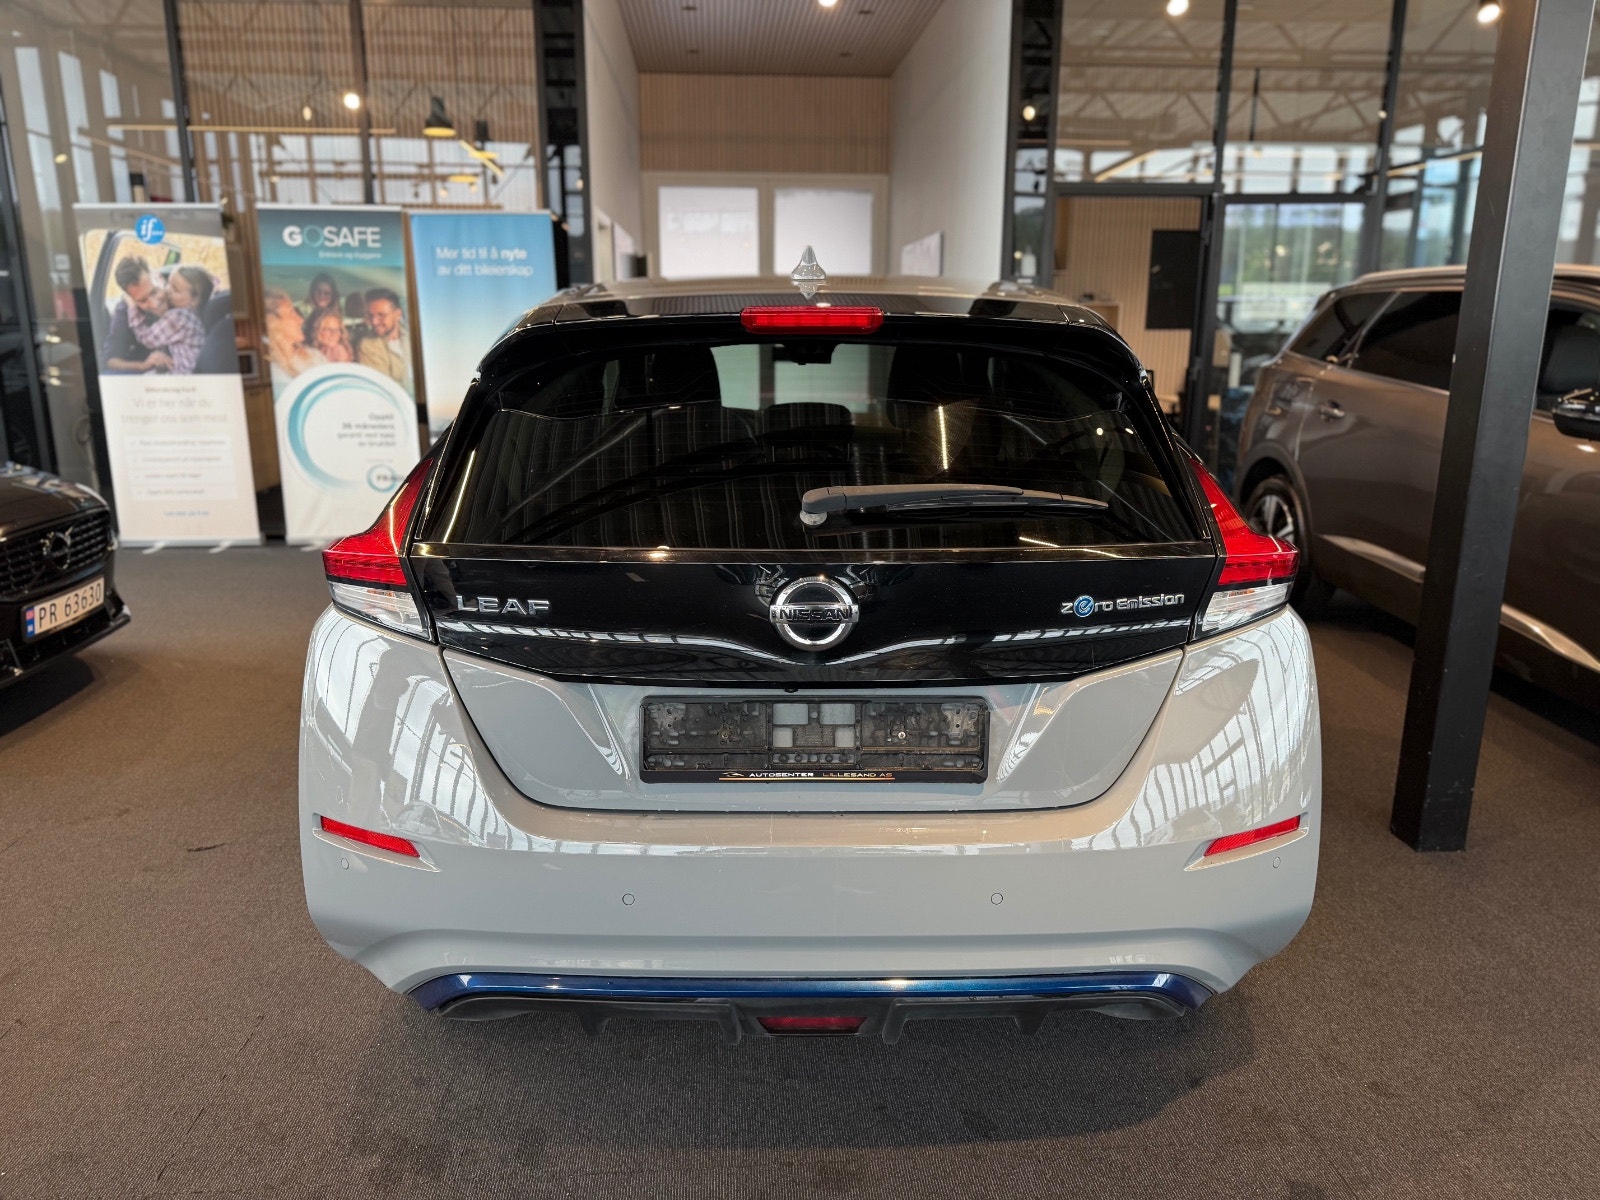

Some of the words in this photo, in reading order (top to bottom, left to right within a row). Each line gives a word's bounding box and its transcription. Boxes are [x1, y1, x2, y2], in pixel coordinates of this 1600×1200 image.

[282, 224, 382, 249] GOSAFE
[500, 247, 528, 262] nyte
[39, 602, 57, 629] PR
[64, 583, 101, 617] 63630
[456, 595, 550, 615] LEAF
[779, 607, 849, 622] NISSAN
